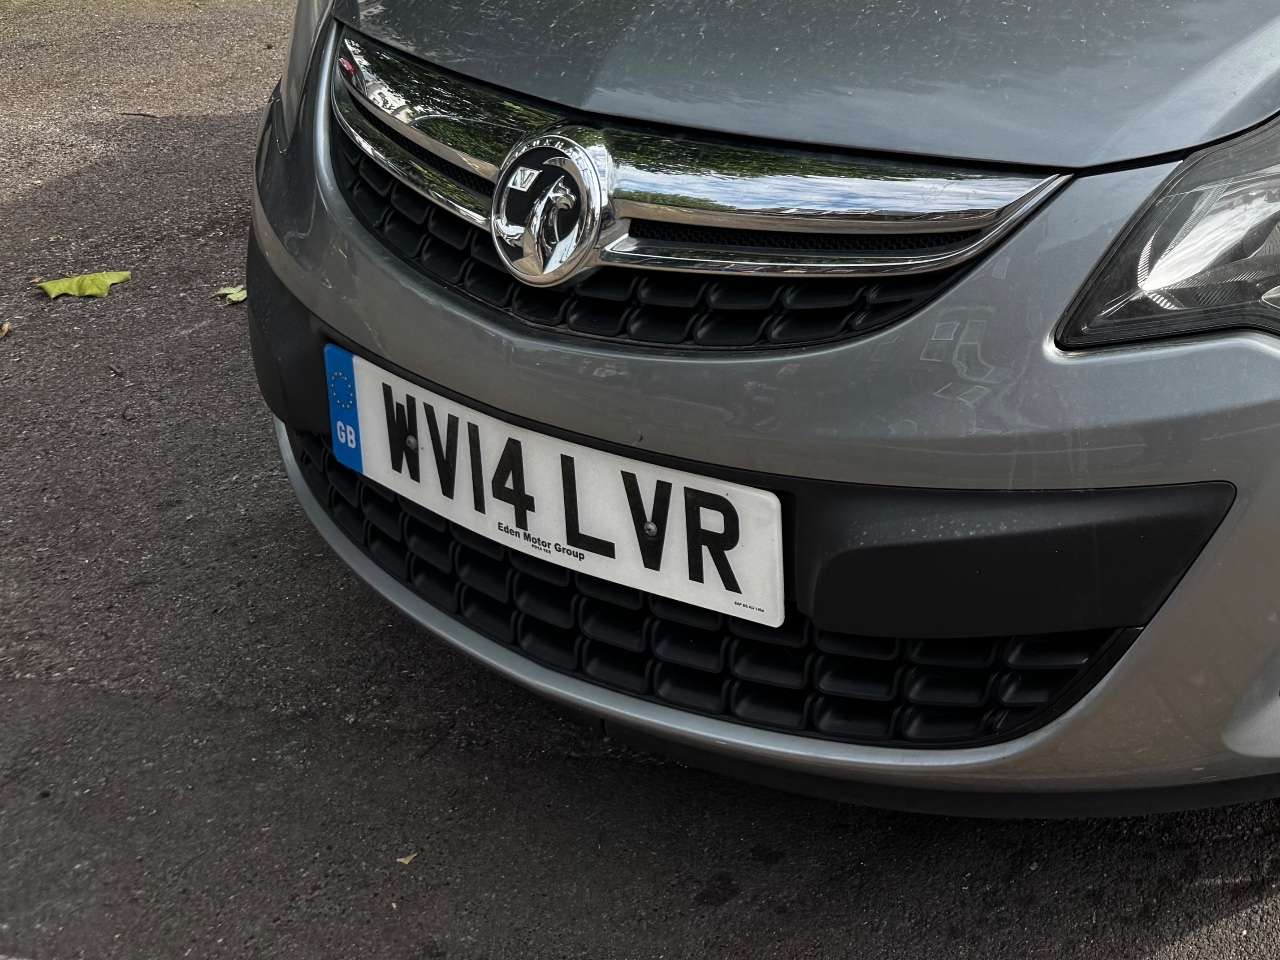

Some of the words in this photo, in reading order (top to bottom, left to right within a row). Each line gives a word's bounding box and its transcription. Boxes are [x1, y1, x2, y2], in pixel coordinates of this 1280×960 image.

[336, 420, 356, 450] GB
[382, 382, 536, 531] WV14
[560, 453, 742, 595] LVR
[497, 521, 521, 539] Eden
[523, 531, 552, 549] Motor
[554, 542, 585, 561] Group
